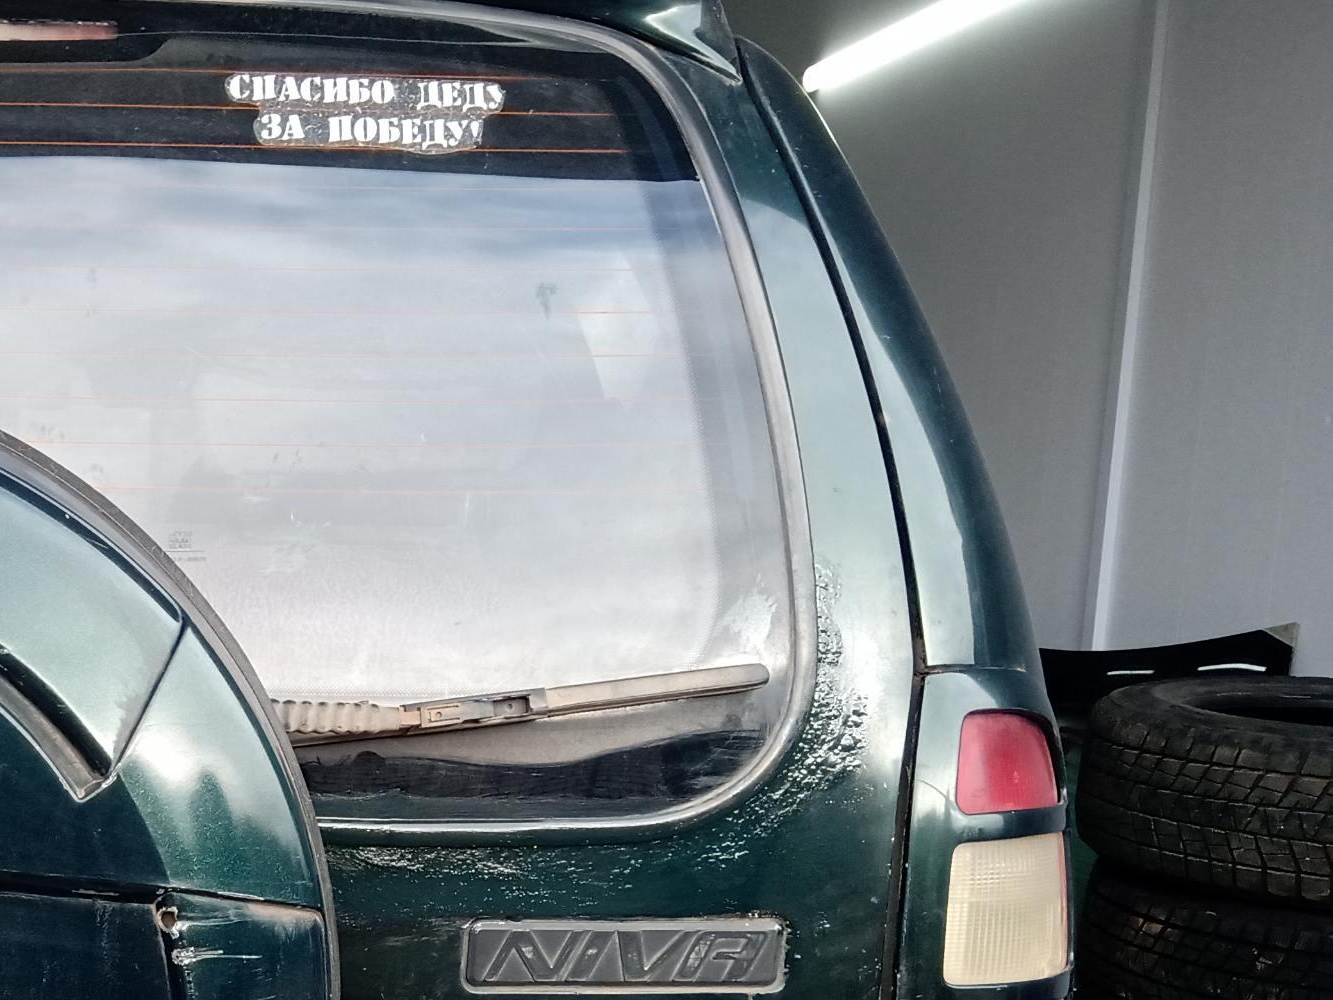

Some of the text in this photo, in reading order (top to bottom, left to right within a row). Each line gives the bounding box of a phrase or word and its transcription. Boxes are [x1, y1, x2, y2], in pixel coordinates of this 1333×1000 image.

[228, 74, 506, 112] СПАСИБО ДЕДУ
[260, 113, 482, 150] ЗА ПОБЕДУ!
[481, 929, 768, 983] NIVA
